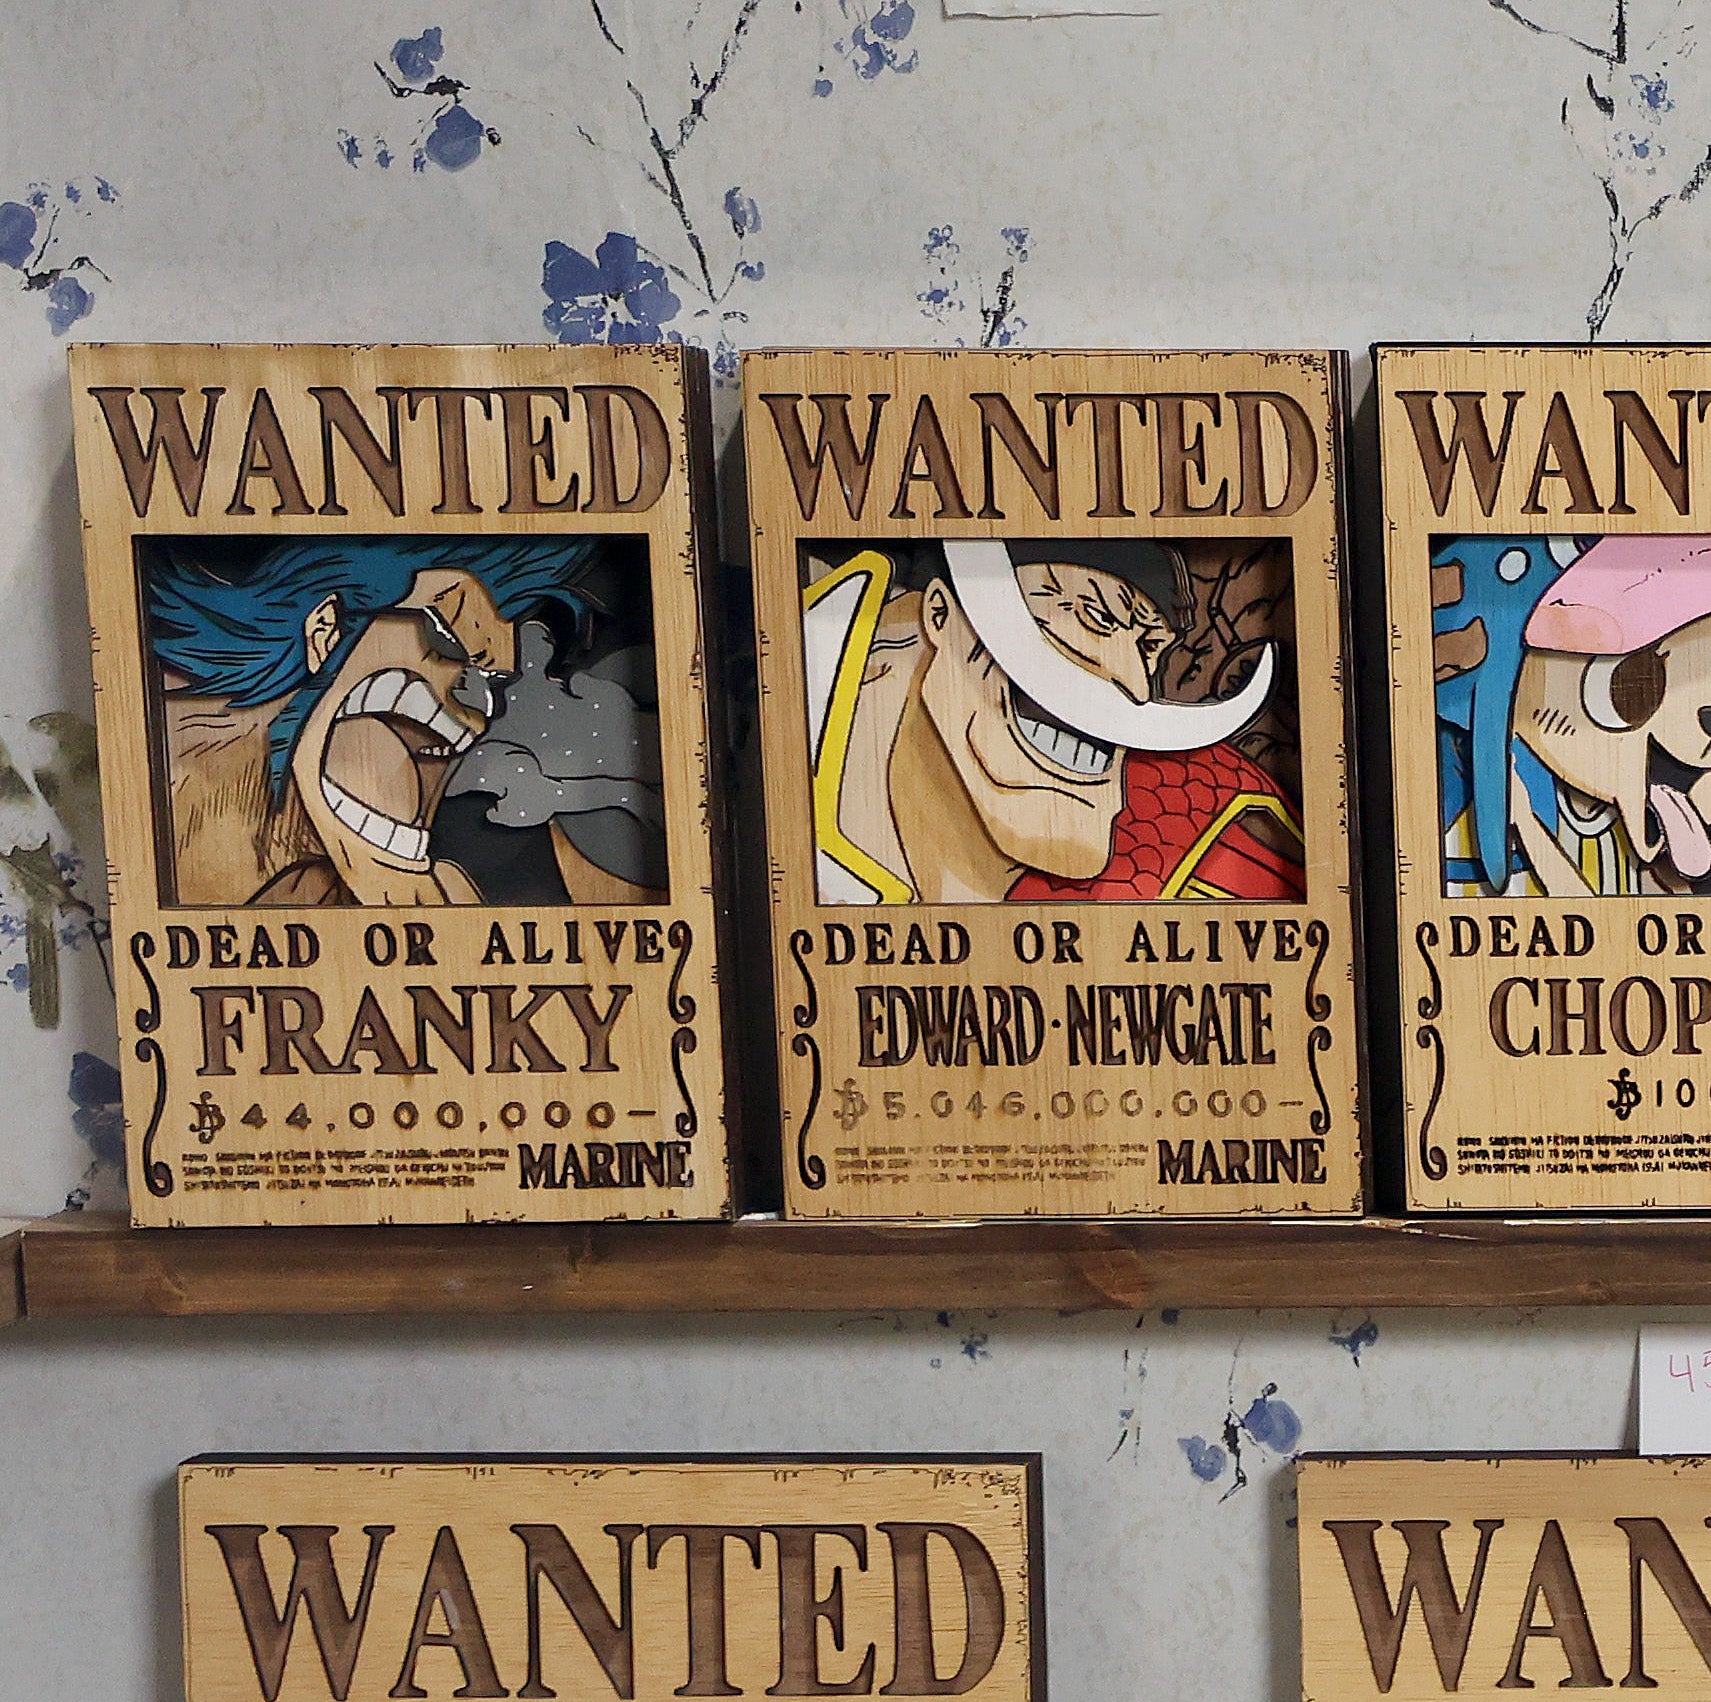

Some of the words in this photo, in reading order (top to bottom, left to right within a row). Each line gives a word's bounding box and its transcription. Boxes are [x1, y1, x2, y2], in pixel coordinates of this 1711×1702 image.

[87, 386, 673, 517] WANTED
[759, 390, 1321, 522] WANTED
[167, 922, 321, 969] DEAD
[365, 921, 437, 967] OR
[481, 918, 669, 966] ALIVE
[825, 922, 971, 966] DEAD
[1013, 920, 1084, 965] OR
[1126, 918, 1306, 964] ALIVE
[1447, 913, 1597, 960] DEAD
[1636, 912, 1704, 957] OR
[191, 984, 633, 1077] FRANKY
[517, 1141, 693, 1190] MARINE
[1157, 1138, 1329, 1186] MARINE
[204, 1520, 1008, 1702] WANTED
